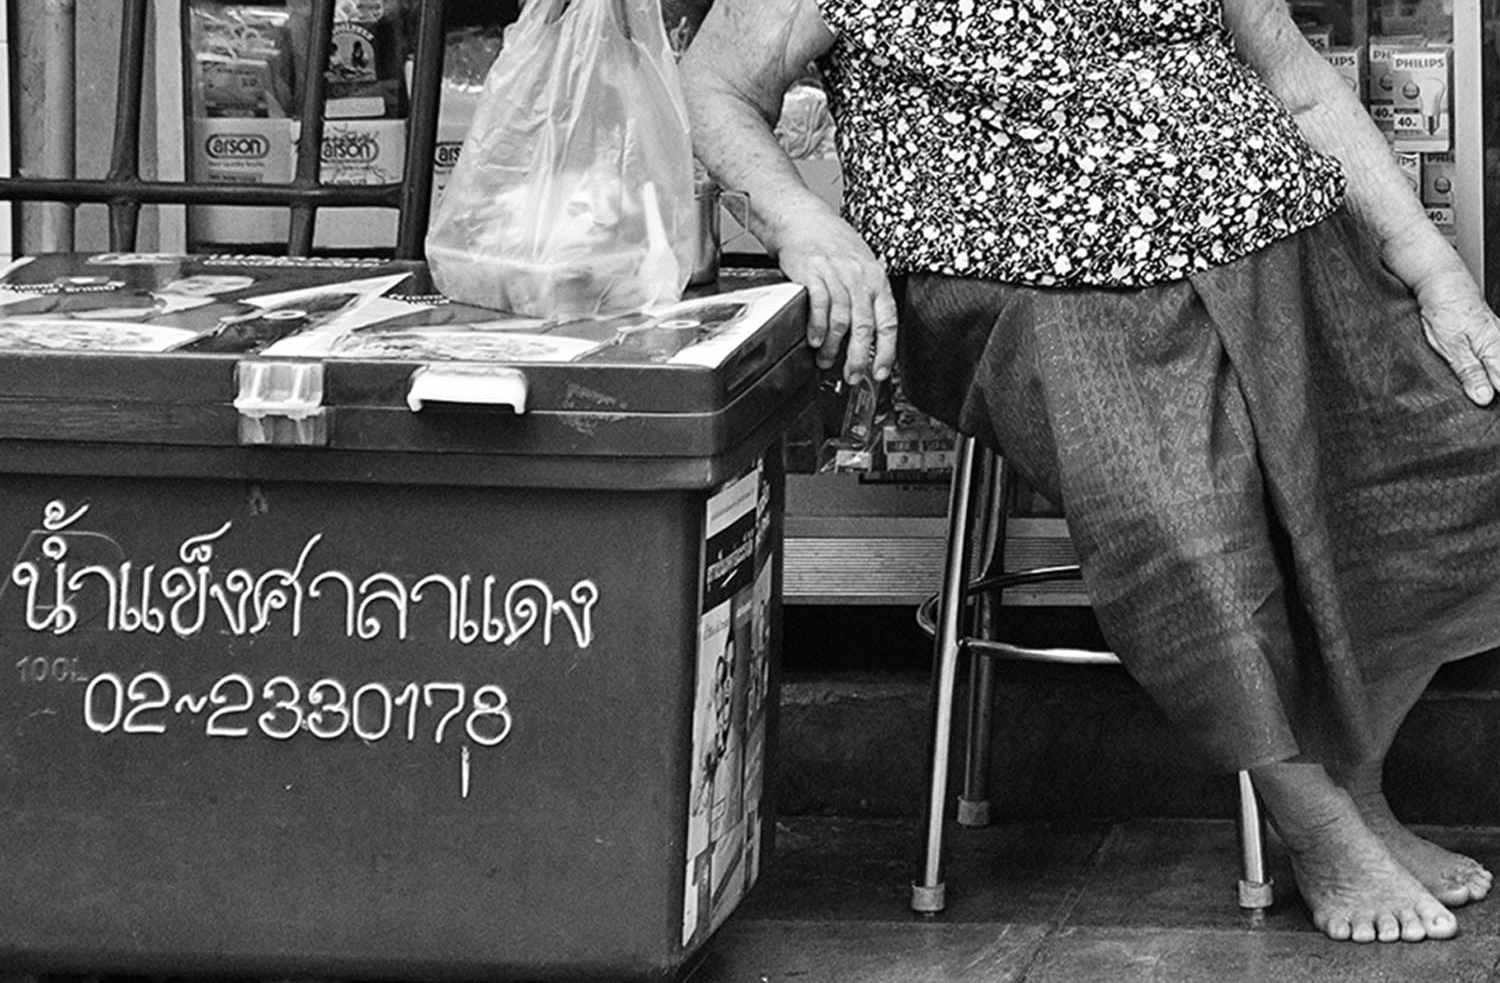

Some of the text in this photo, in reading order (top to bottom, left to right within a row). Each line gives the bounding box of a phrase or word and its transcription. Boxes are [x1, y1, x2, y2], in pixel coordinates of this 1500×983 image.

[1395, 58, 1445, 68] PHILIPS
[212, 136, 262, 156] arson
[322, 140, 371, 160] arson
[437, 145, 463, 161] ars
[12, 501, 598, 648] น้ำแข็งศาลาแดง
